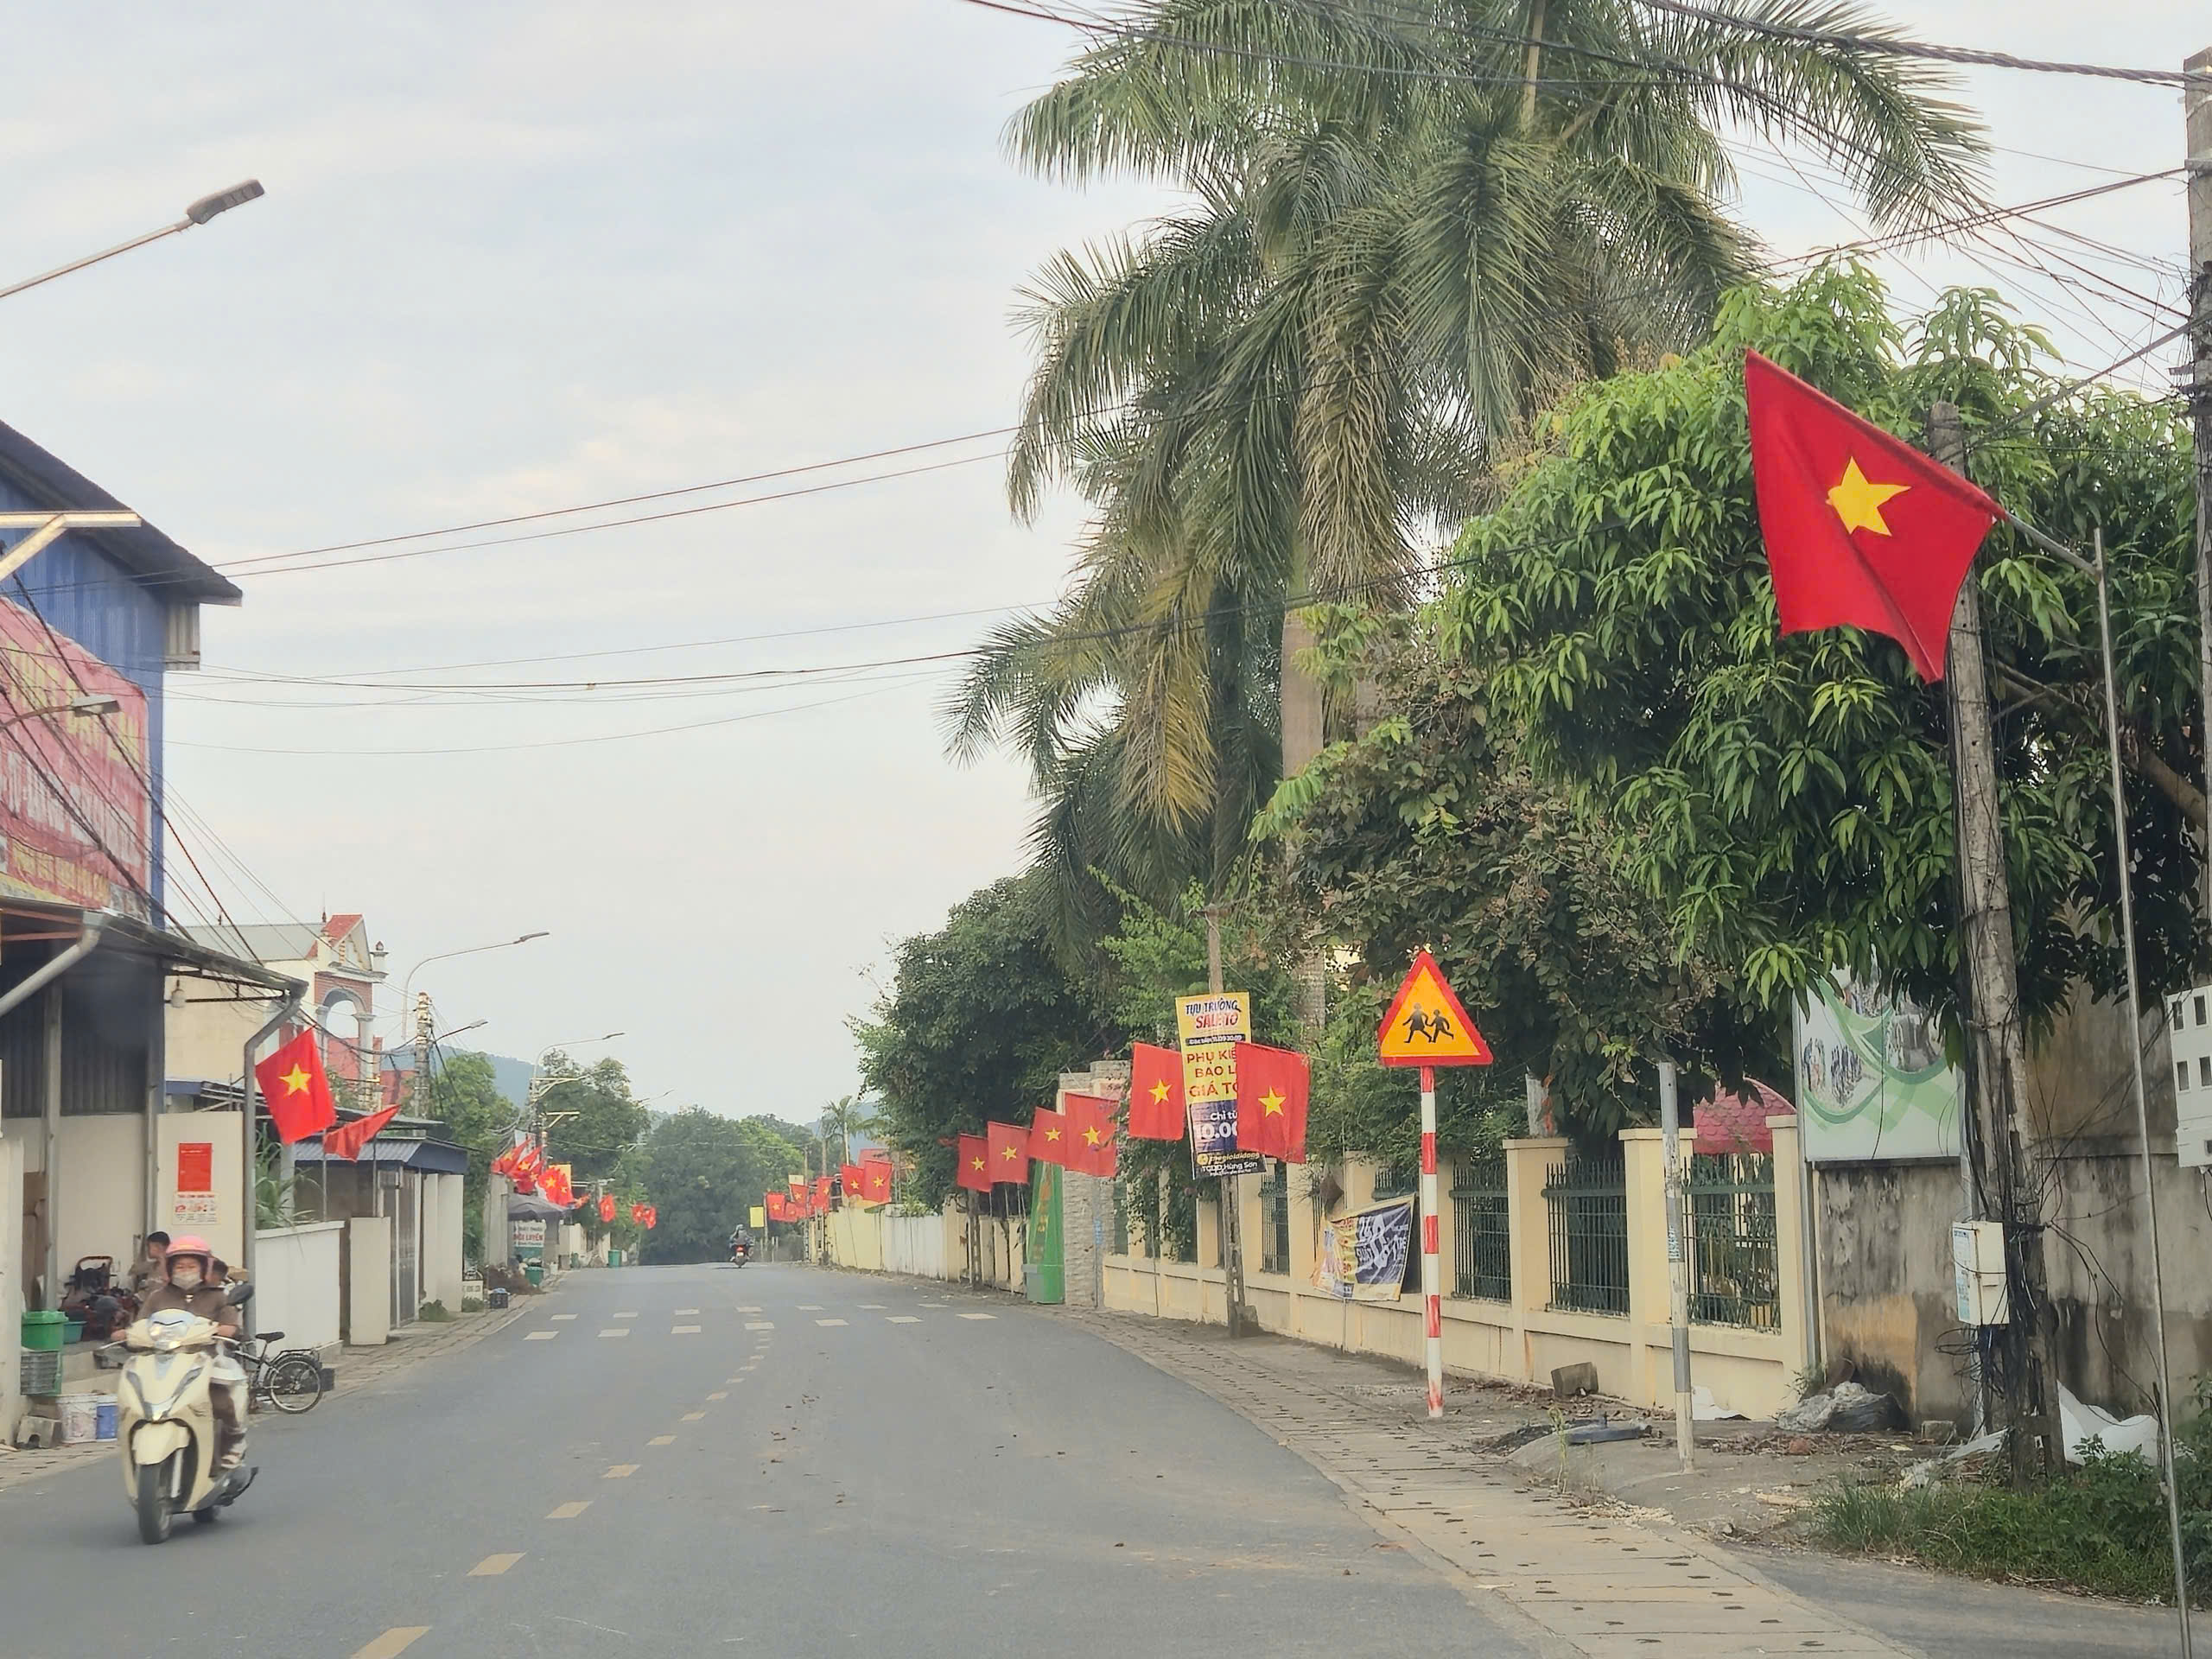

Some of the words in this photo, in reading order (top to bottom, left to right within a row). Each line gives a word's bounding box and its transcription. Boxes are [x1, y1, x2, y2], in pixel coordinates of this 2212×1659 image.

[1186, 1052, 1214, 1064] PHỤ
[1218, 1047, 1236, 1062] KIỆ
[1195, 1065, 1224, 1077] BAO
[1189, 1080, 1218, 1096] GIÁ
